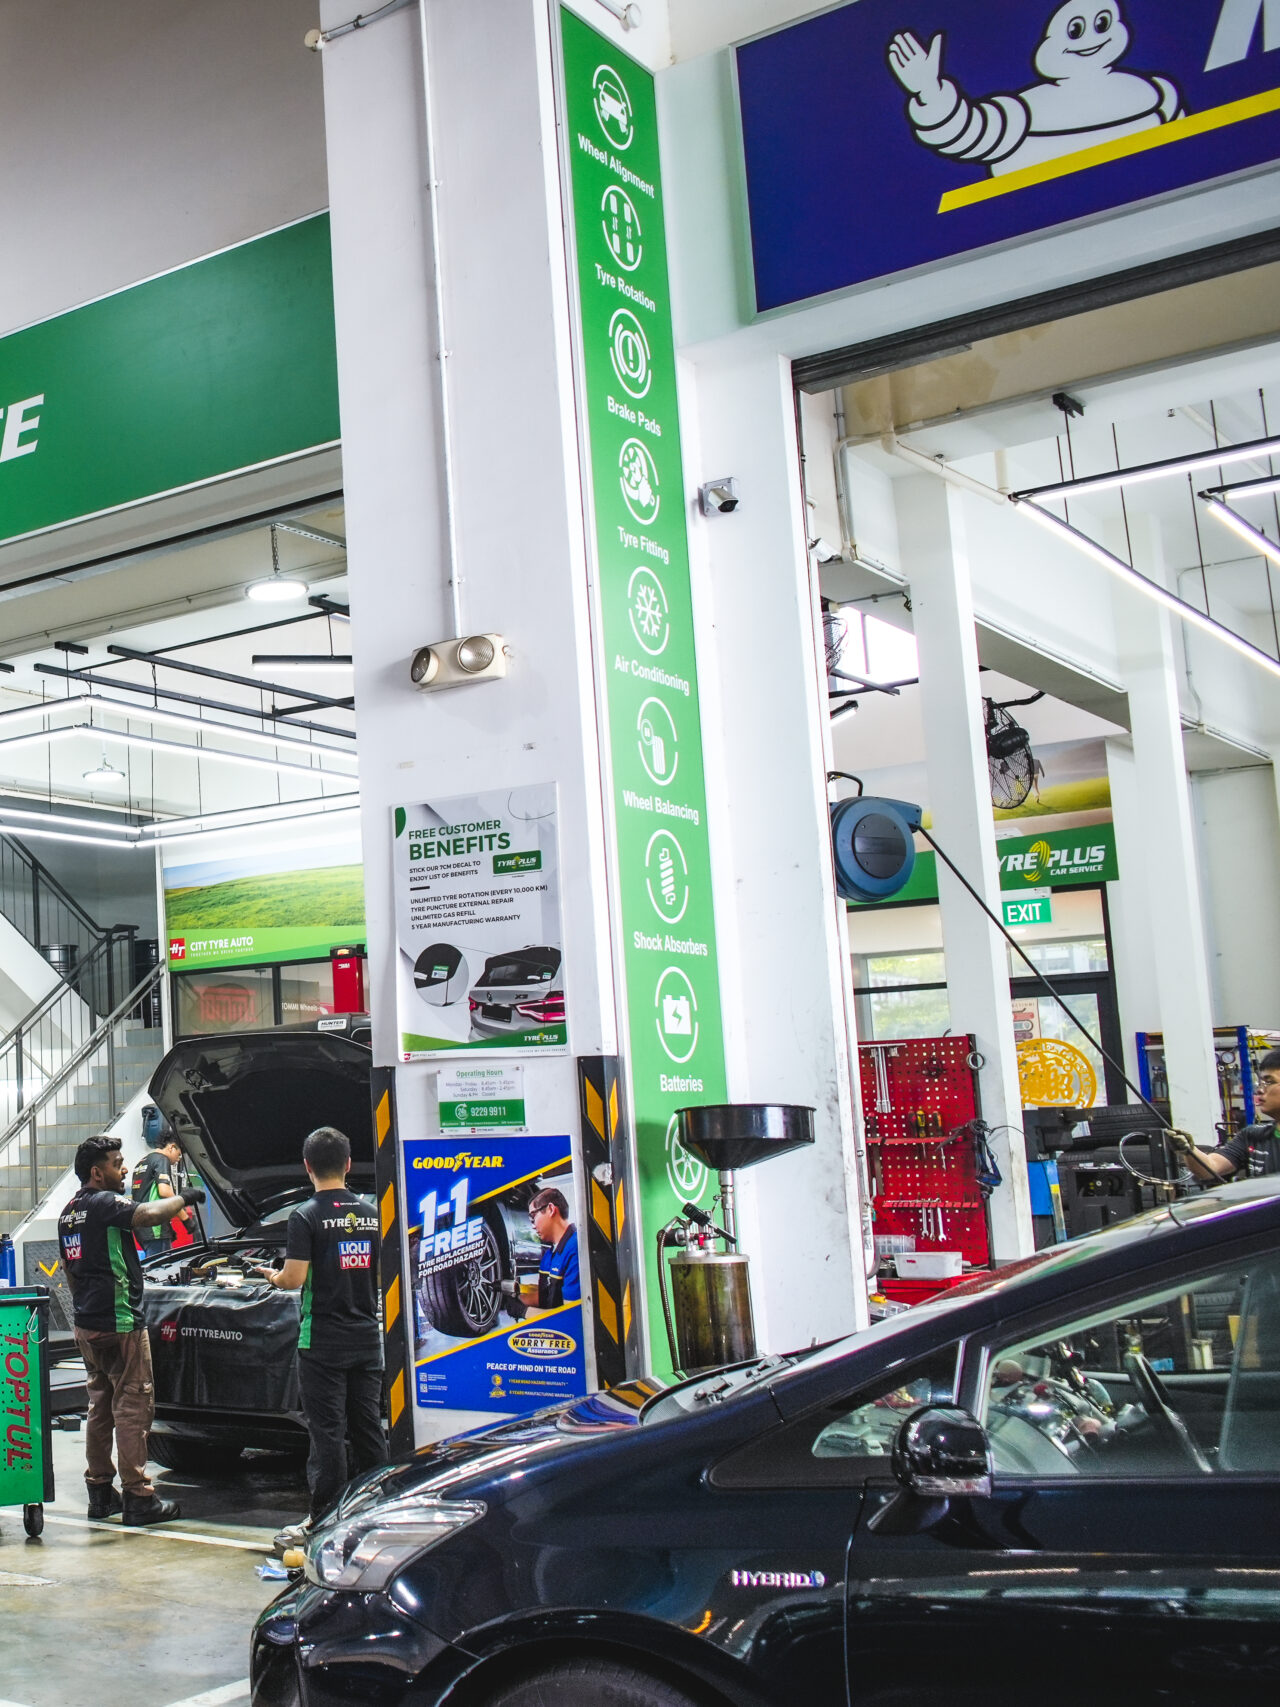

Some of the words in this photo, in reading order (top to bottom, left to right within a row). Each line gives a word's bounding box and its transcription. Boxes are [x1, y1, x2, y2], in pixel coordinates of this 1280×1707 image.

[577, 133, 608, 166] Wheel
[609, 155, 655, 198] Alignment
[595, 262, 616, 289] Tyre
[618, 276, 656, 313] Rotation
[607, 395, 637, 424] Brake
[638, 410, 662, 437] Pads
[617, 525, 639, 549] Tyre
[640, 535, 670, 565] Fitting
[614, 655, 630, 673] Air
[631, 659, 690, 696] Conditioning
[622, 789, 654, 813] Wheel
[655, 795, 700, 825] Balancing
[409, 828, 436, 840] FREE
[438, 820, 501, 836] CUSTOMER
[409, 832, 511, 860] BENEFITS
[409, 866, 426, 874] STICK
[426, 864, 439, 872] OUR
[439, 863, 452, 871] 7CM
[452, 861, 472, 869] DECAL
[997, 852, 1039, 873] YRE
[1050, 868, 1067, 876] CAR
[1068, 864, 1104, 874] SERVICE
[409, 875, 428, 883] ENJOY
[450, 869, 478, 878] BENEFITS
[410, 896, 442, 904] UNLIMITED
[442, 894, 458, 902] TYRE
[458, 891, 490, 900] ROTATION
[426, 902, 458, 911] PUNCTURE
[458, 899, 491, 908] EXTERNAL
[491, 897, 514, 905] REPAIR
[411, 913, 442, 922] UNLIMITED
[442, 911, 456, 919] GAS
[1007, 902, 1042, 922] EXIT
[416, 922, 432, 930] YEAR
[432, 917, 484, 928] MANUFACTURING
[484, 914, 521, 923] WARRANTY
[190, 941, 207, 952] CITY
[208, 938, 230, 950] TYRE
[230, 936, 254, 947] AUTO
[633, 931, 663, 952] Shock
[664, 934, 708, 957] Absorbers
[456, 1070, 486, 1078] Operating
[660, 1073, 703, 1094] Batteries
[470, 1107, 488, 1117] 9229
[489, 1106, 506, 1116] 9911
[412, 1153, 504, 1171] GOODYEAR
[419, 1178, 469, 1238] 1-1
[340, 1242, 370, 1254] LIQUI
[419, 1217, 484, 1262] FREE
[418, 1258, 435, 1271] TYRE
[436, 1239, 485, 1263] REPLACEMENT
[418, 1268, 433, 1279] FOR
[433, 1260, 453, 1273] ROAD
[180, 1327, 198, 1337] CITY
[512, 1338, 545, 1347] WORRY
[549, 1340, 571, 1349] FREE
[486, 1362, 507, 1371] PEACE
[508, 1363, 517, 1371] OF
[517, 1364, 534, 1372] MIND
[534, 1365, 544, 1373] ON
[544, 1365, 558, 1374] THE
[558, 1366, 577, 1374] ROAD
[732, 1569, 814, 1588] HYBRID
